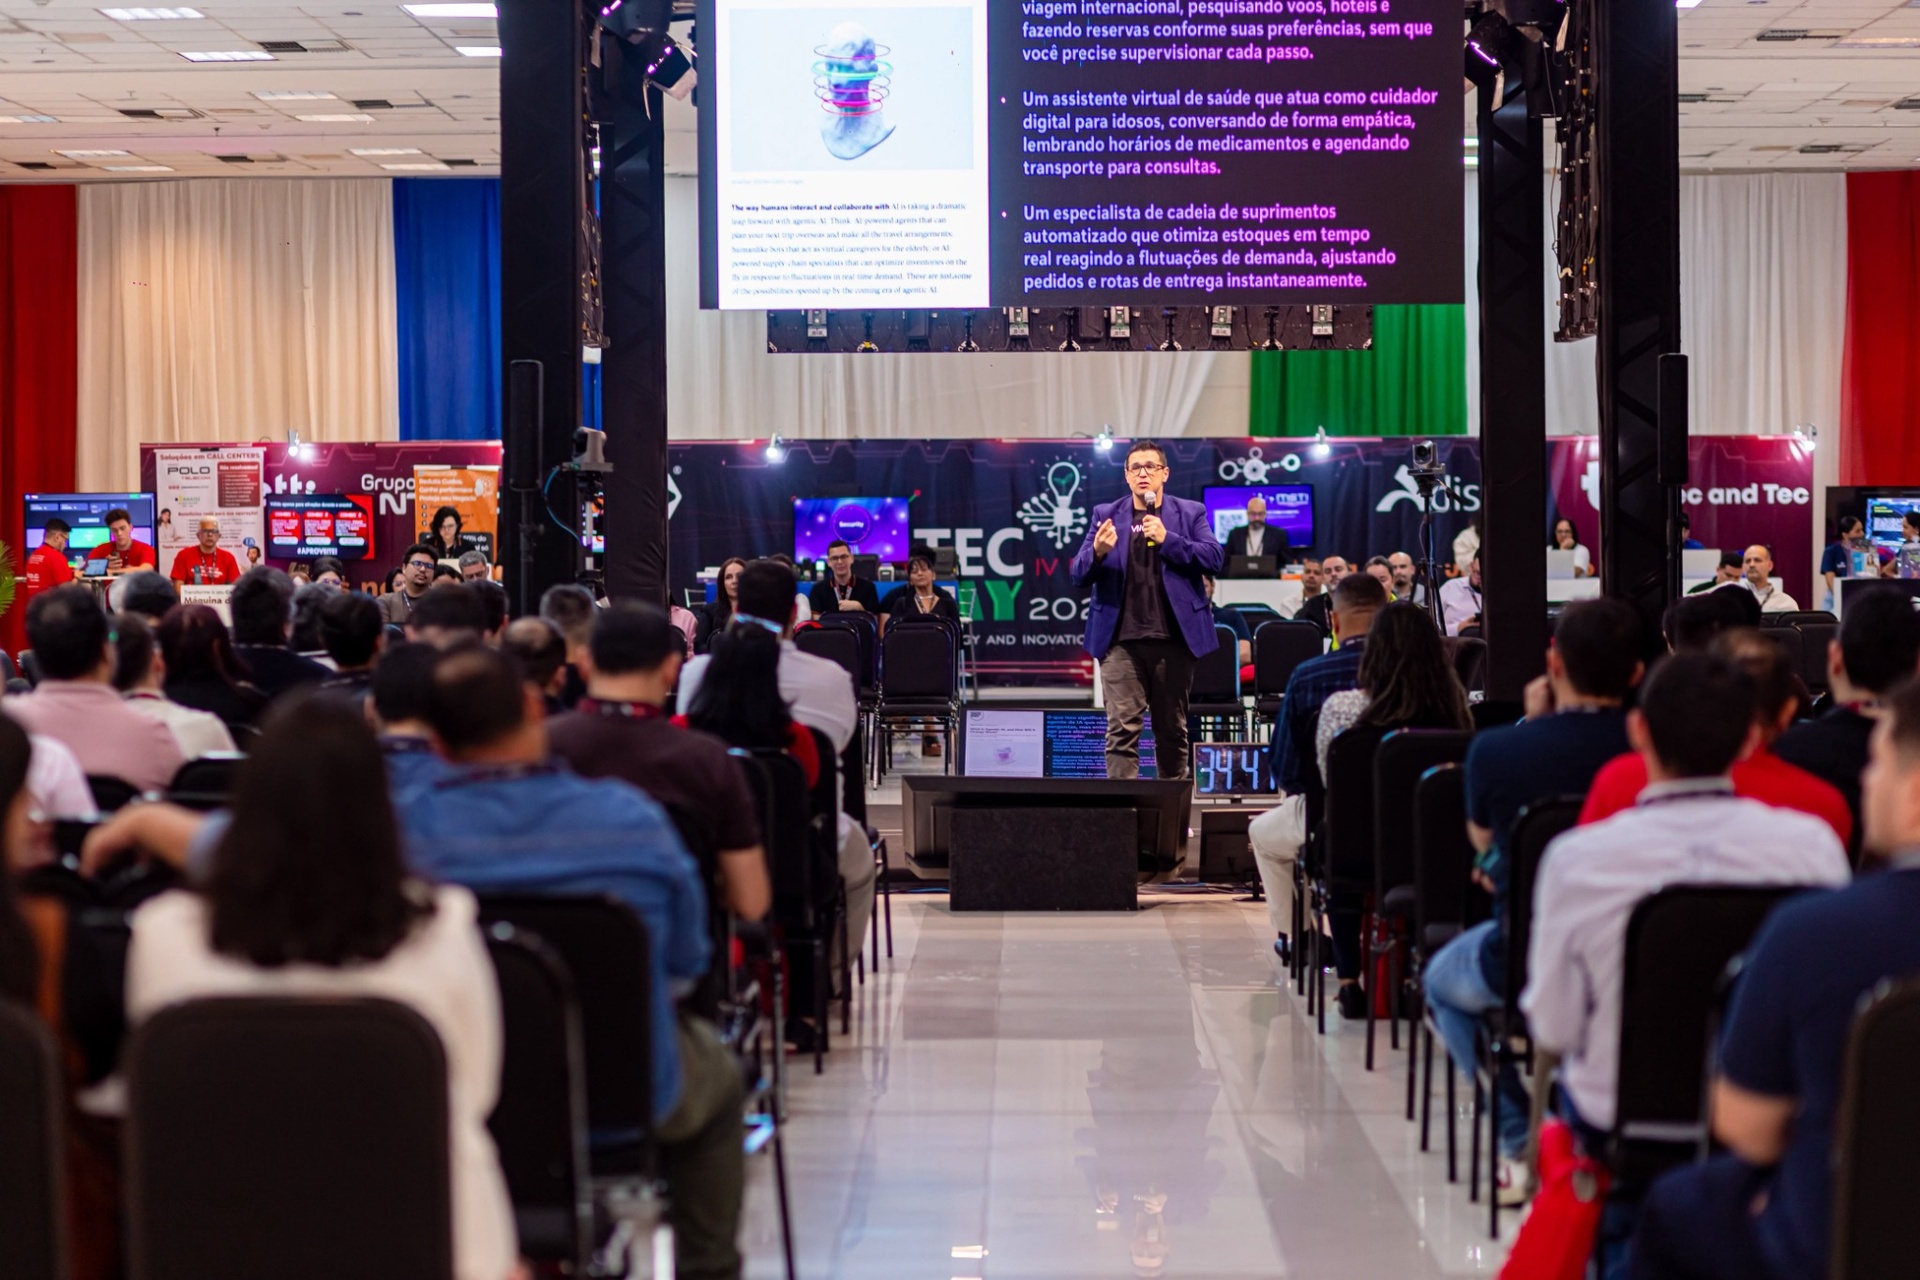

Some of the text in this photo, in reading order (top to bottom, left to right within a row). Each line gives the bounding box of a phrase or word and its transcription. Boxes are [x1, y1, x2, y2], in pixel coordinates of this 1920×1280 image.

[1021, 0, 1078, 19] viagem
[1081, 0, 1184, 20] internacional,
[1188, 0, 1284, 17] pesquisando
[1286, 1, 1327, 15] voos,
[1380, 1, 1390, 11] e
[1021, 19, 1433, 40] fazendo reservas conforme suas preferências, sem que
[1021, 43, 1314, 66] você precise supervisionar cada passo.
[1022, 88, 1439, 108] Um assistente virtual de saúde que atua como cuidador
[1022, 111, 1416, 132] digital para idosos, conversando de forma empática,
[1022, 134, 1410, 153] lembrando horários de medicamentos e agendando
[1022, 158, 1221, 179] transporte para consultas.
[907, 203, 930, 211] taking
[936, 202, 967, 210] dramatic
[1023, 203, 1337, 224] Um especialista de cadeia de suprimentos
[731, 217, 746, 226] leap
[792, 217, 816, 226] agentic
[918, 216, 932, 224] that
[731, 231, 747, 240] plan
[748, 232, 764, 240] your
[782, 231, 795, 240] trip
[861, 230, 870, 238] all
[870, 230, 881, 238] the
[883, 230, 903, 238] travel
[1023, 226, 1370, 246] automatizado que otimiza estoques em tempo
[1023, 248, 1396, 270] real reagindo a flutuações de demanda, ajustando
[1023, 272, 1367, 293] pedidos e rotas de entrega instantaneamente.
[167, 466, 211, 475] POLO
[1707, 482, 1758, 505] and
[1762, 483, 1810, 505] Tec
[913, 528, 1024, 577] TEC
[1034, 558, 1059, 576] IV
[184, 596, 222, 605] Máquina
[958, 580, 1023, 621] AY
[986, 634, 1016, 645] AND
[1022, 634, 1085, 645] INOVATIO
